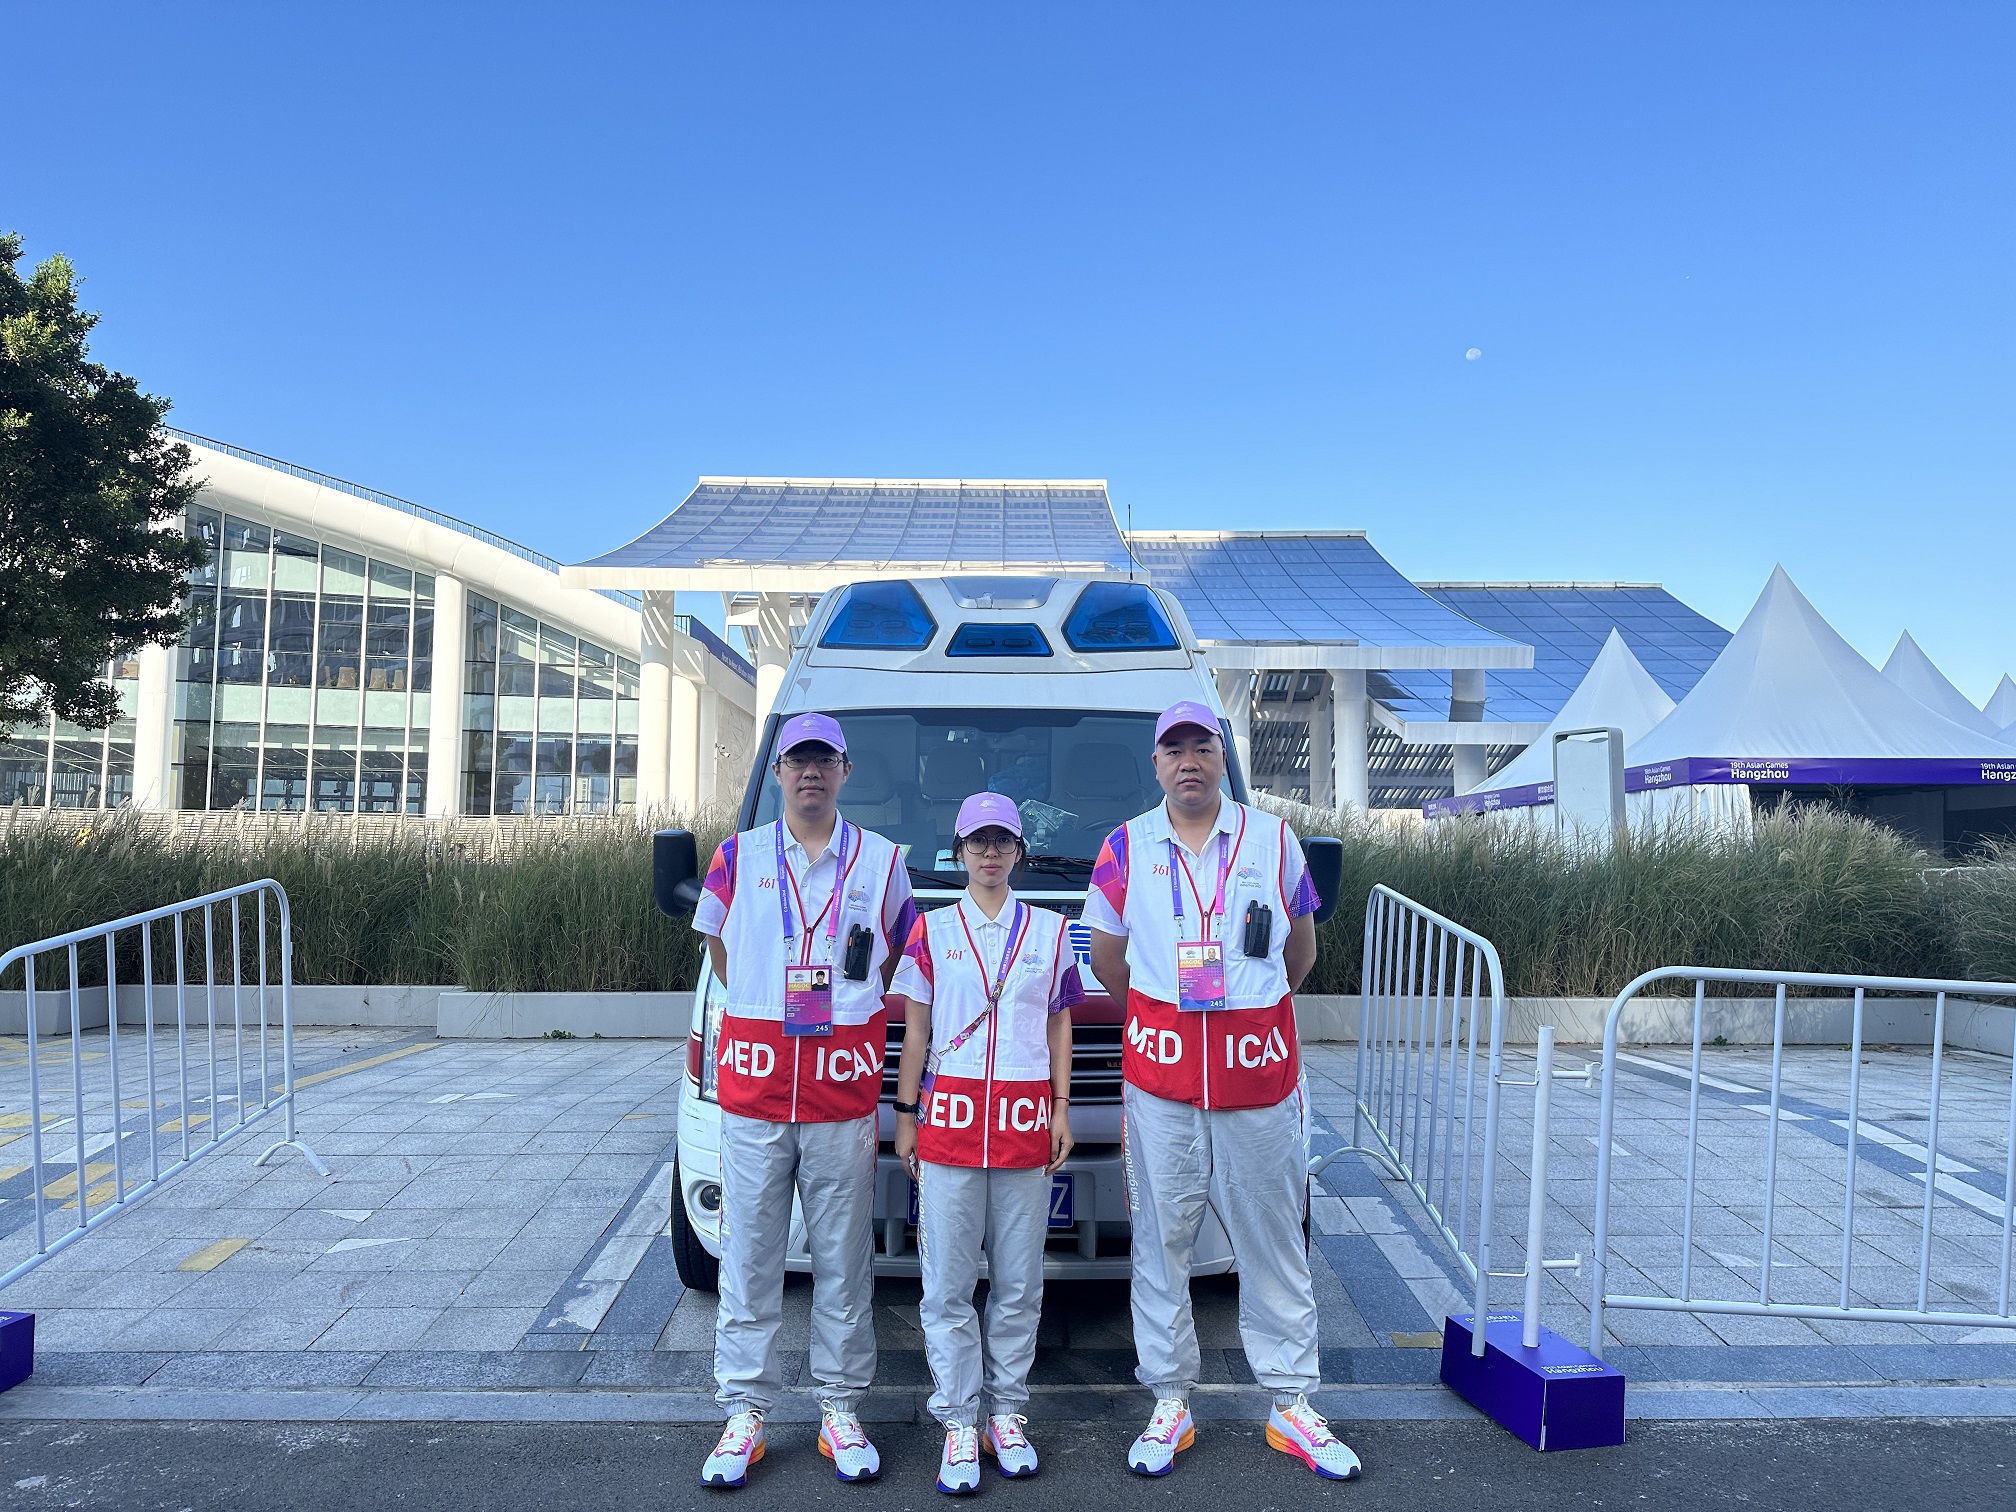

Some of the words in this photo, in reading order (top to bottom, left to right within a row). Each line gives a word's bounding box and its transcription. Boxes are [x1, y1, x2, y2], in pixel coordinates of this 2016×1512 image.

[1730, 761, 1745, 769] 19th
[1746, 761, 1765, 769] Asian
[1765, 761, 1789, 769] Games
[1981, 762, 1996, 770] 19th
[1996, 762, 2015, 770] Asian
[1644, 772, 1672, 785] Hangzhou
[1730, 769, 1789, 780] Hangzhou
[815, 1041, 884, 1082] ICAL
[926, 1091, 975, 1129] ED
[998, 1095, 1051, 1132] ICA
[1124, 1148, 1140, 1211] Hangzhou
